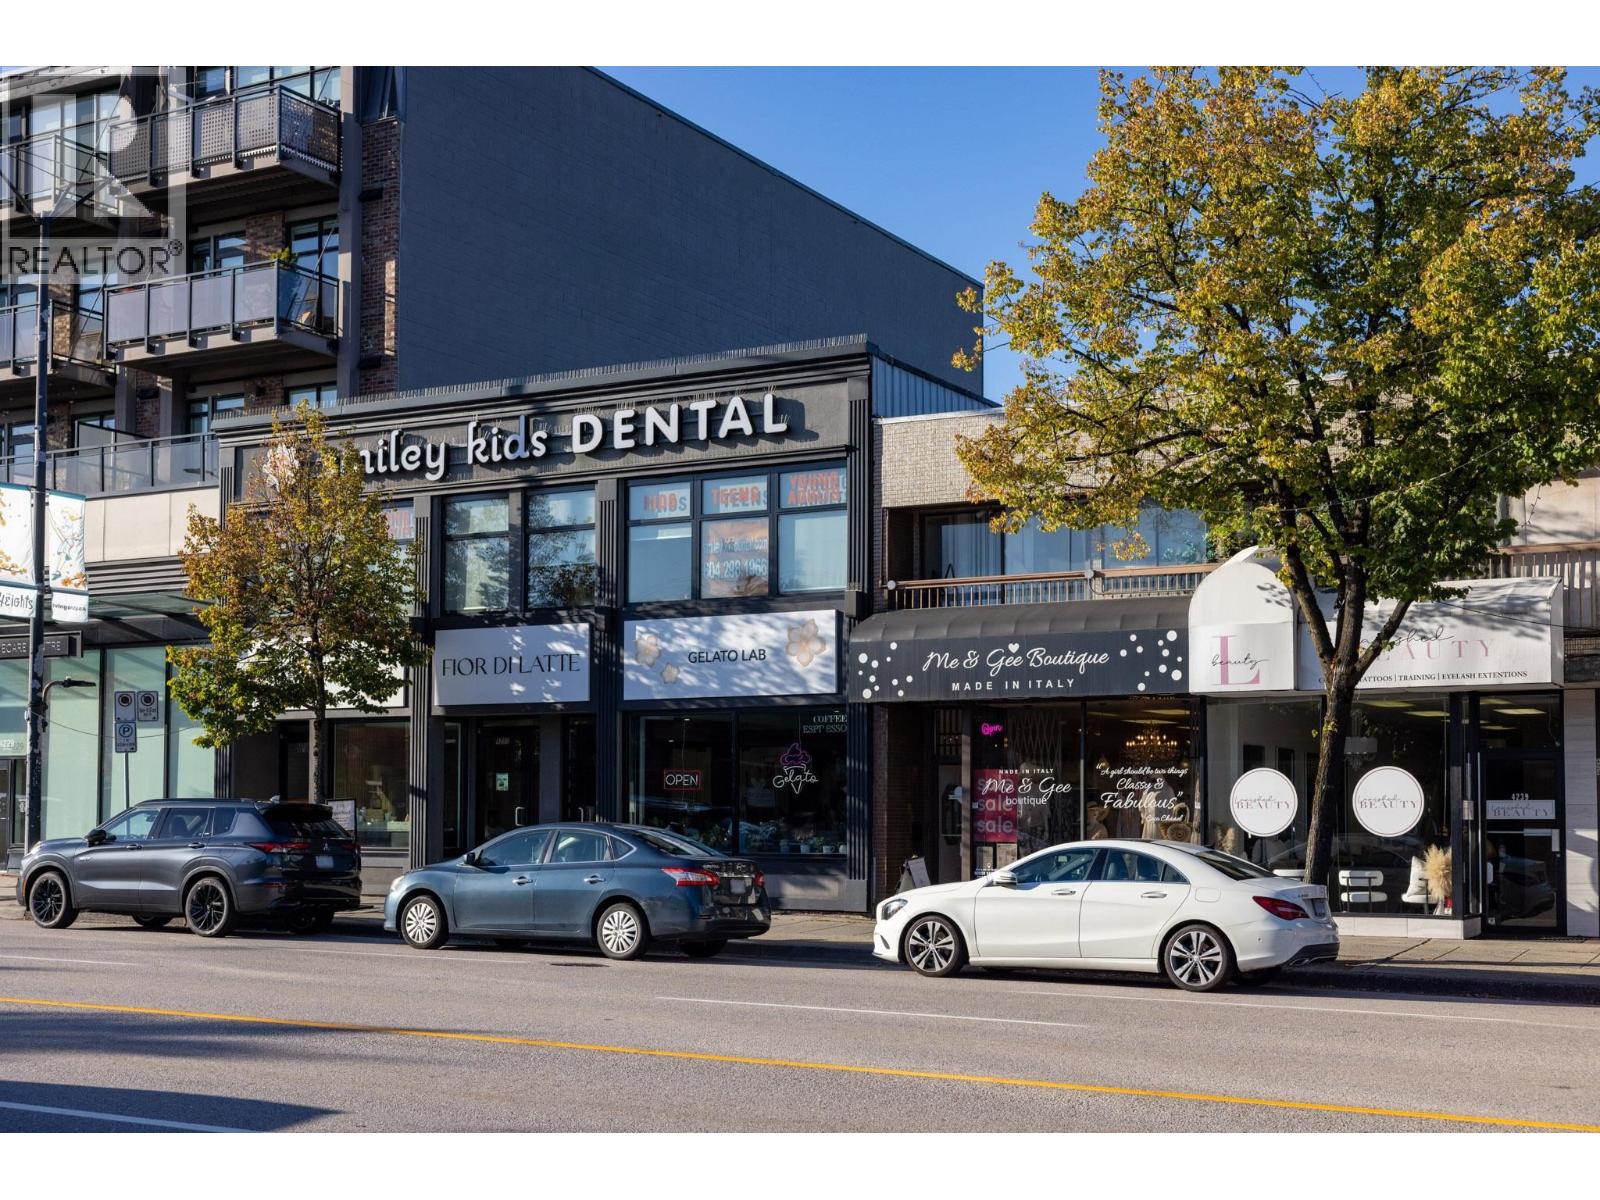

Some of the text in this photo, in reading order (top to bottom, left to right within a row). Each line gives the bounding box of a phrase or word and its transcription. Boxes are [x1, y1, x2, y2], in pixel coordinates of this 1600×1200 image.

[345, 392, 788, 481] iley kids DENTAL
[688, 648, 767, 664] GELATO LAB
[922, 647, 1110, 677] Me & Gee Boutique
[442, 652, 581, 677] FIOR DI LATTE
[1398, 673, 1436, 682] TRAINING
[1441, 671, 1477, 681] EYELASH
[1477, 669, 1528, 680] EXTENTIONS
[952, 678, 1075, 692] MADE IN ITALY
[772, 769, 819, 789] Gelato
[1167, 766, 1189, 778] things
[665, 774, 699, 786] OPEN
[1116, 777, 1165, 794] Classy &
[982, 776, 1072, 801] Me & Gee
[1005, 795, 1047, 807] boutique
[1236, 800, 1290, 809] BEAUTY
[1360, 800, 1417, 809] BEAUTY
[1493, 808, 1550, 817] BEAUTY
[977, 815, 1014, 834] sale
